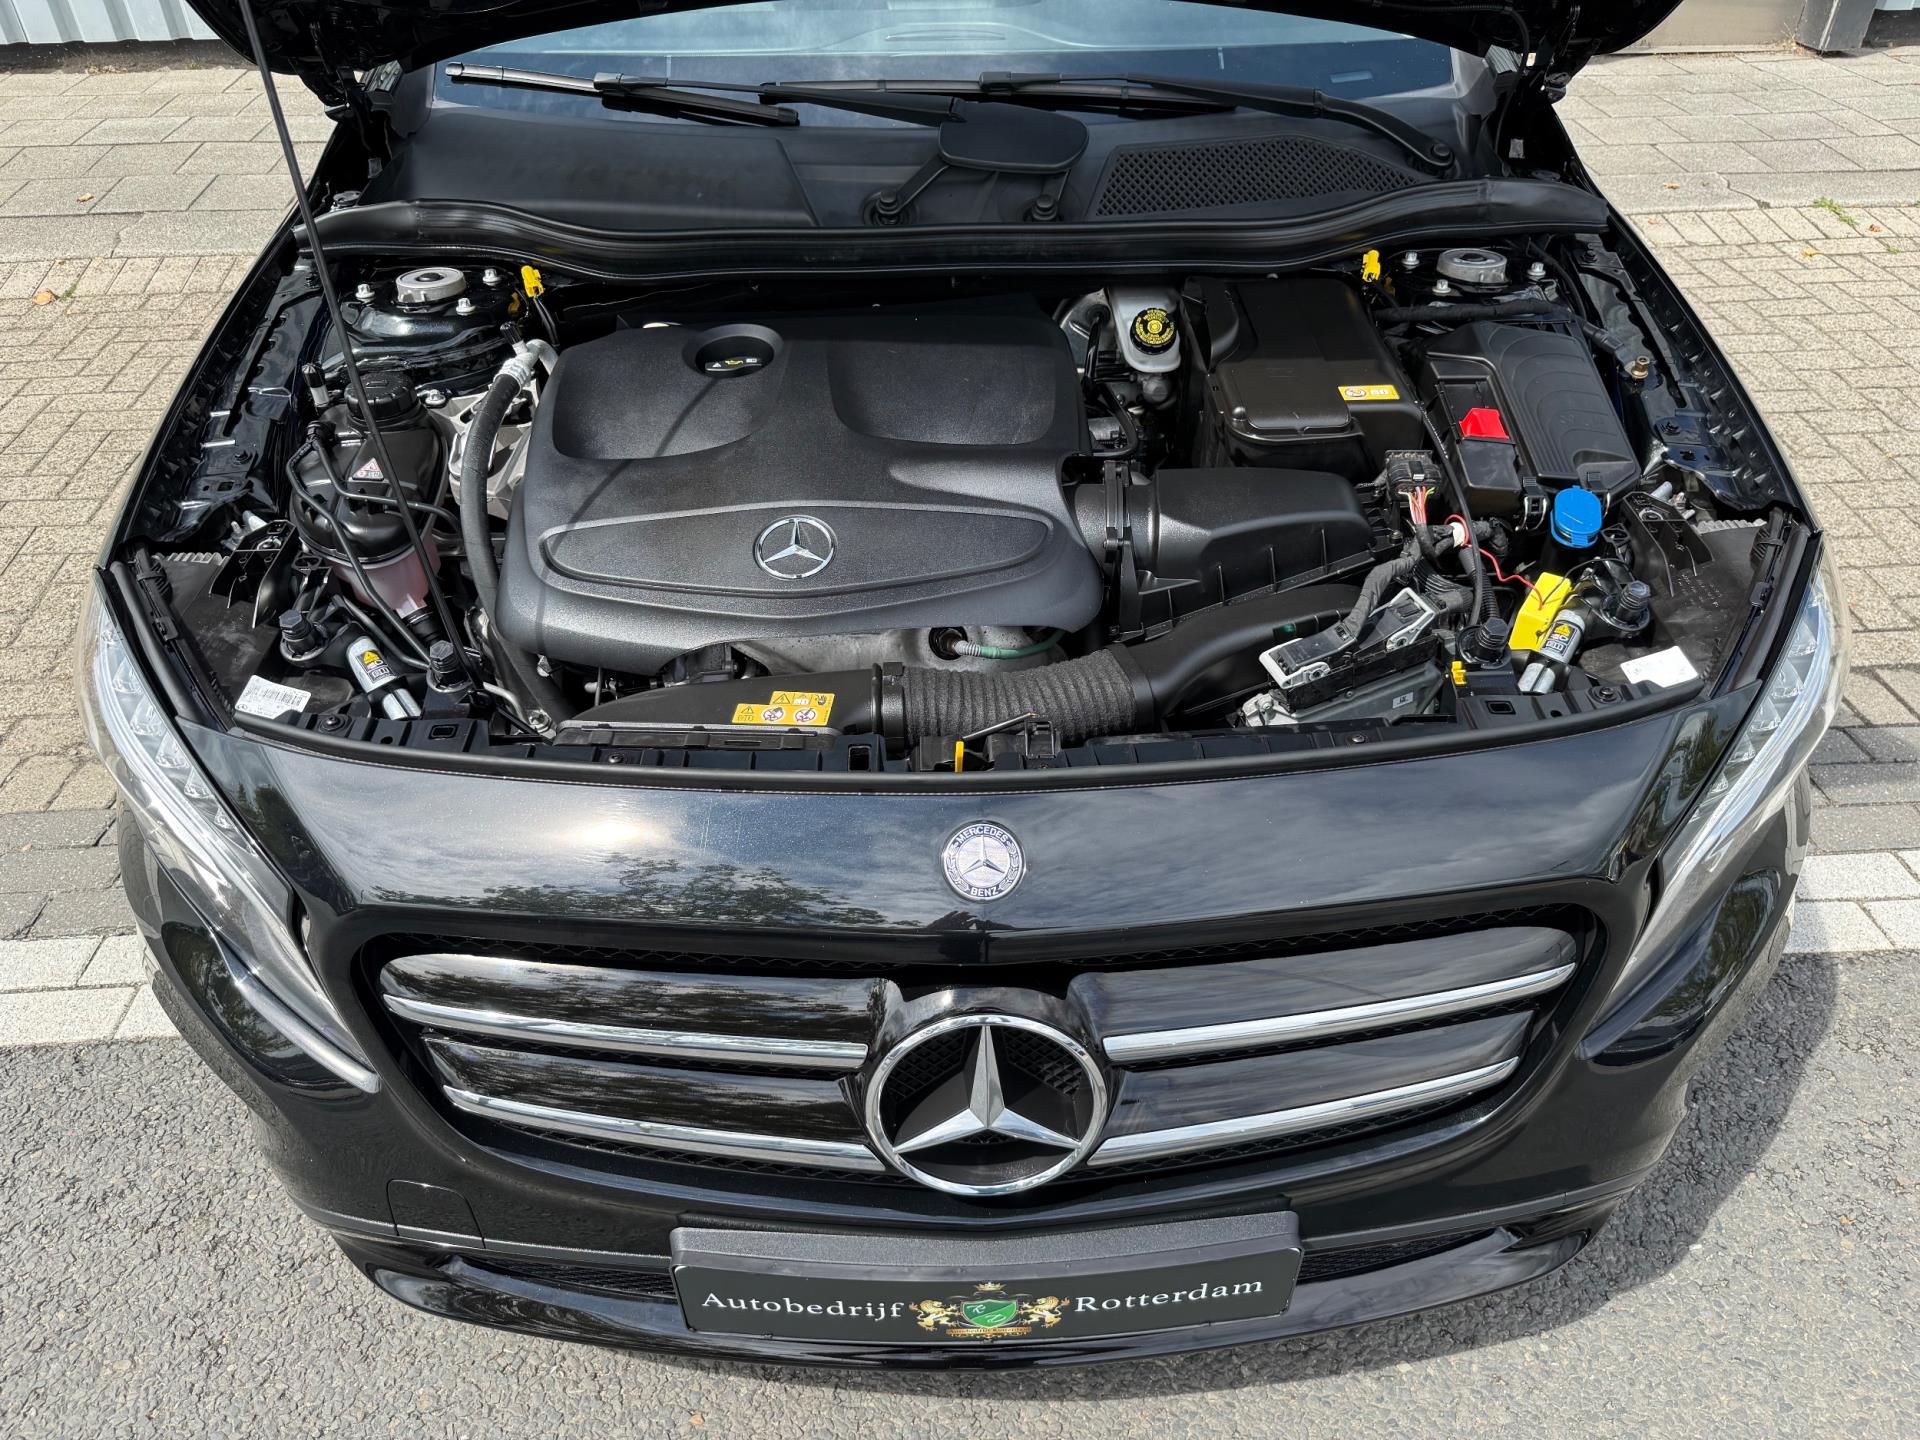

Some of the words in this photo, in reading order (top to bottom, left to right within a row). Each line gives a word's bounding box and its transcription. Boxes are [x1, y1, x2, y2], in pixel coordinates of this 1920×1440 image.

[956, 826, 1009, 844] MERCEDES
[970, 886, 999, 897] BENZ
[702, 1292, 905, 1322] Autobedrijf
[1074, 1278, 1264, 1313] Rotterdam
